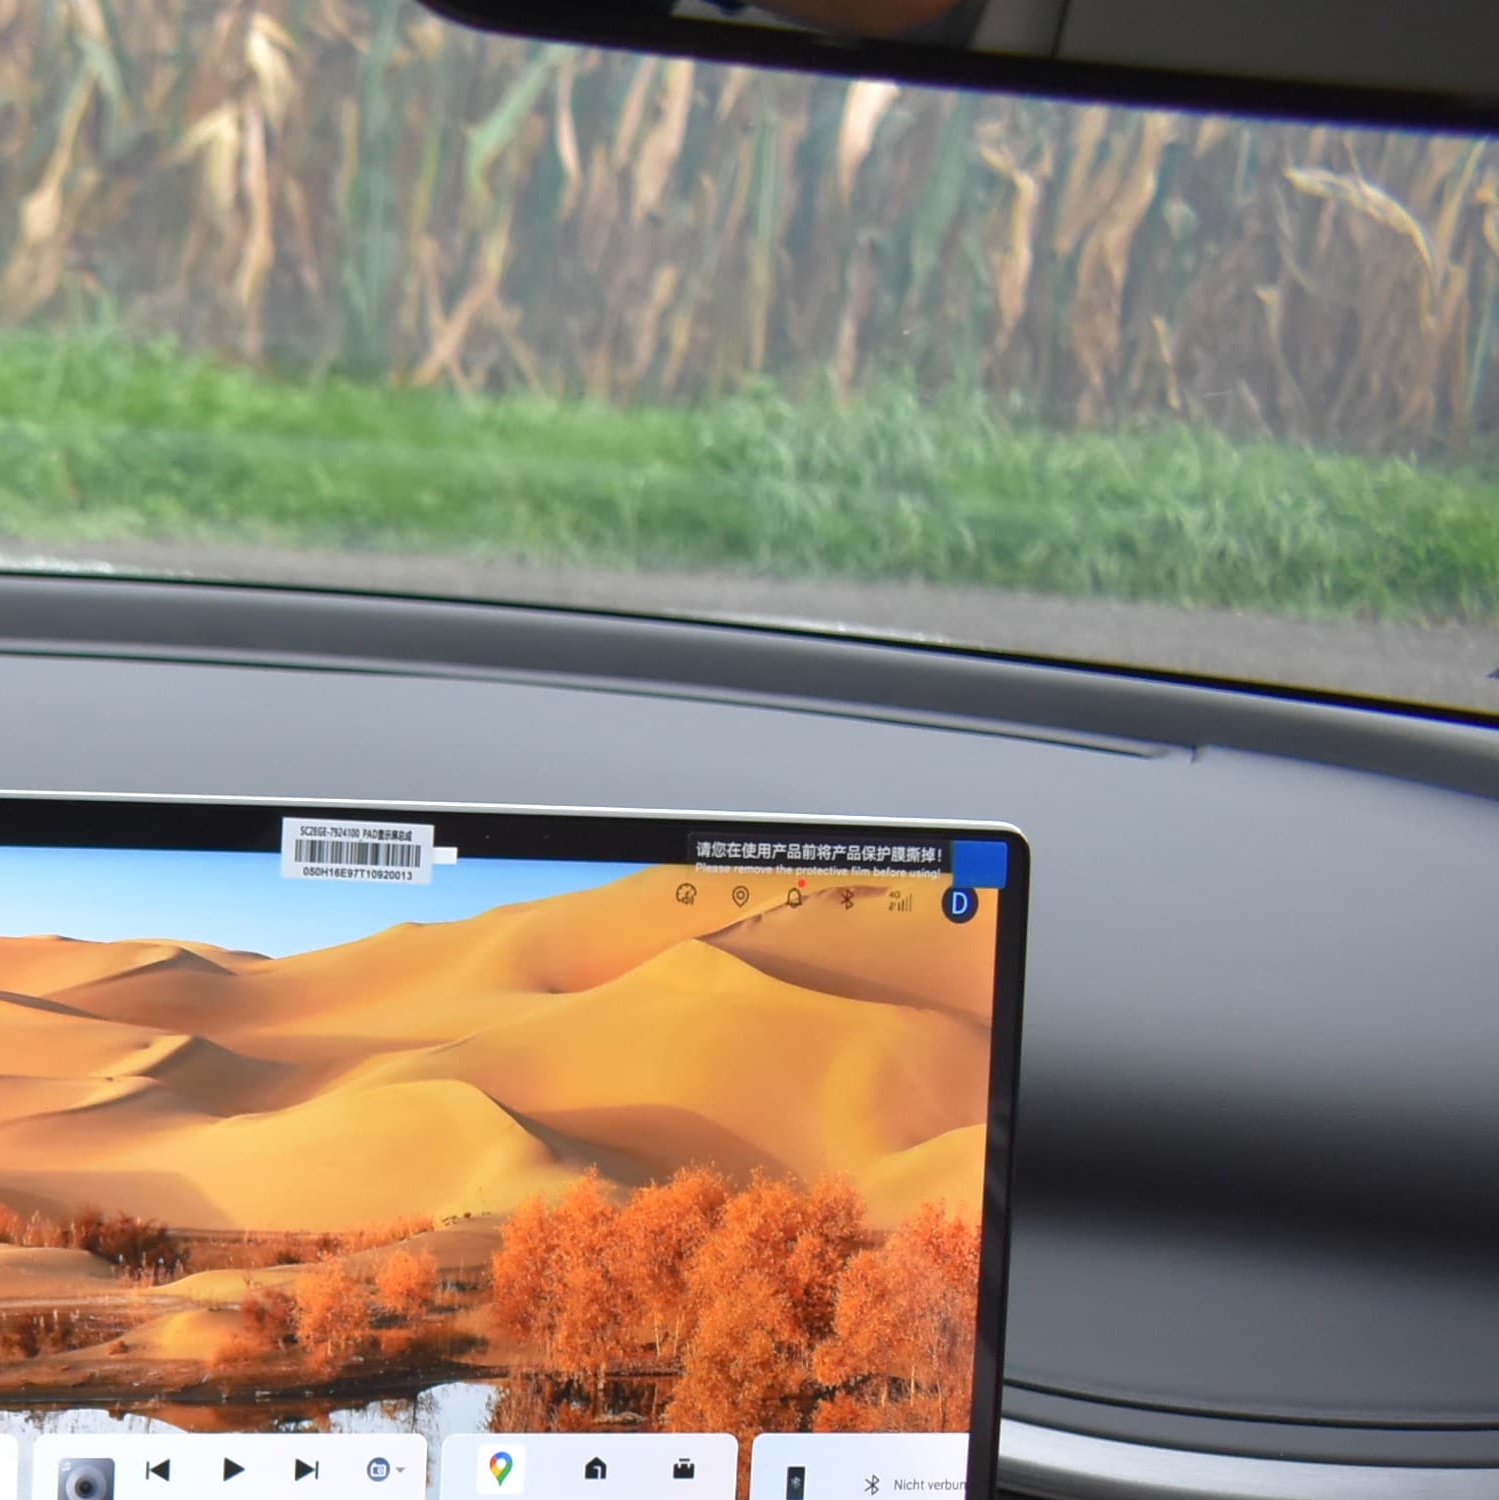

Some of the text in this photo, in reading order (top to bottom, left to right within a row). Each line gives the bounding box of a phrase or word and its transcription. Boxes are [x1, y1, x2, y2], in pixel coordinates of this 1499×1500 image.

[734, 865, 773, 875] remove
[776, 865, 793, 875] the
[796, 866, 849, 878] protective
[951, 891, 968, 915] D
[893, 1478, 924, 1491] Nicht
